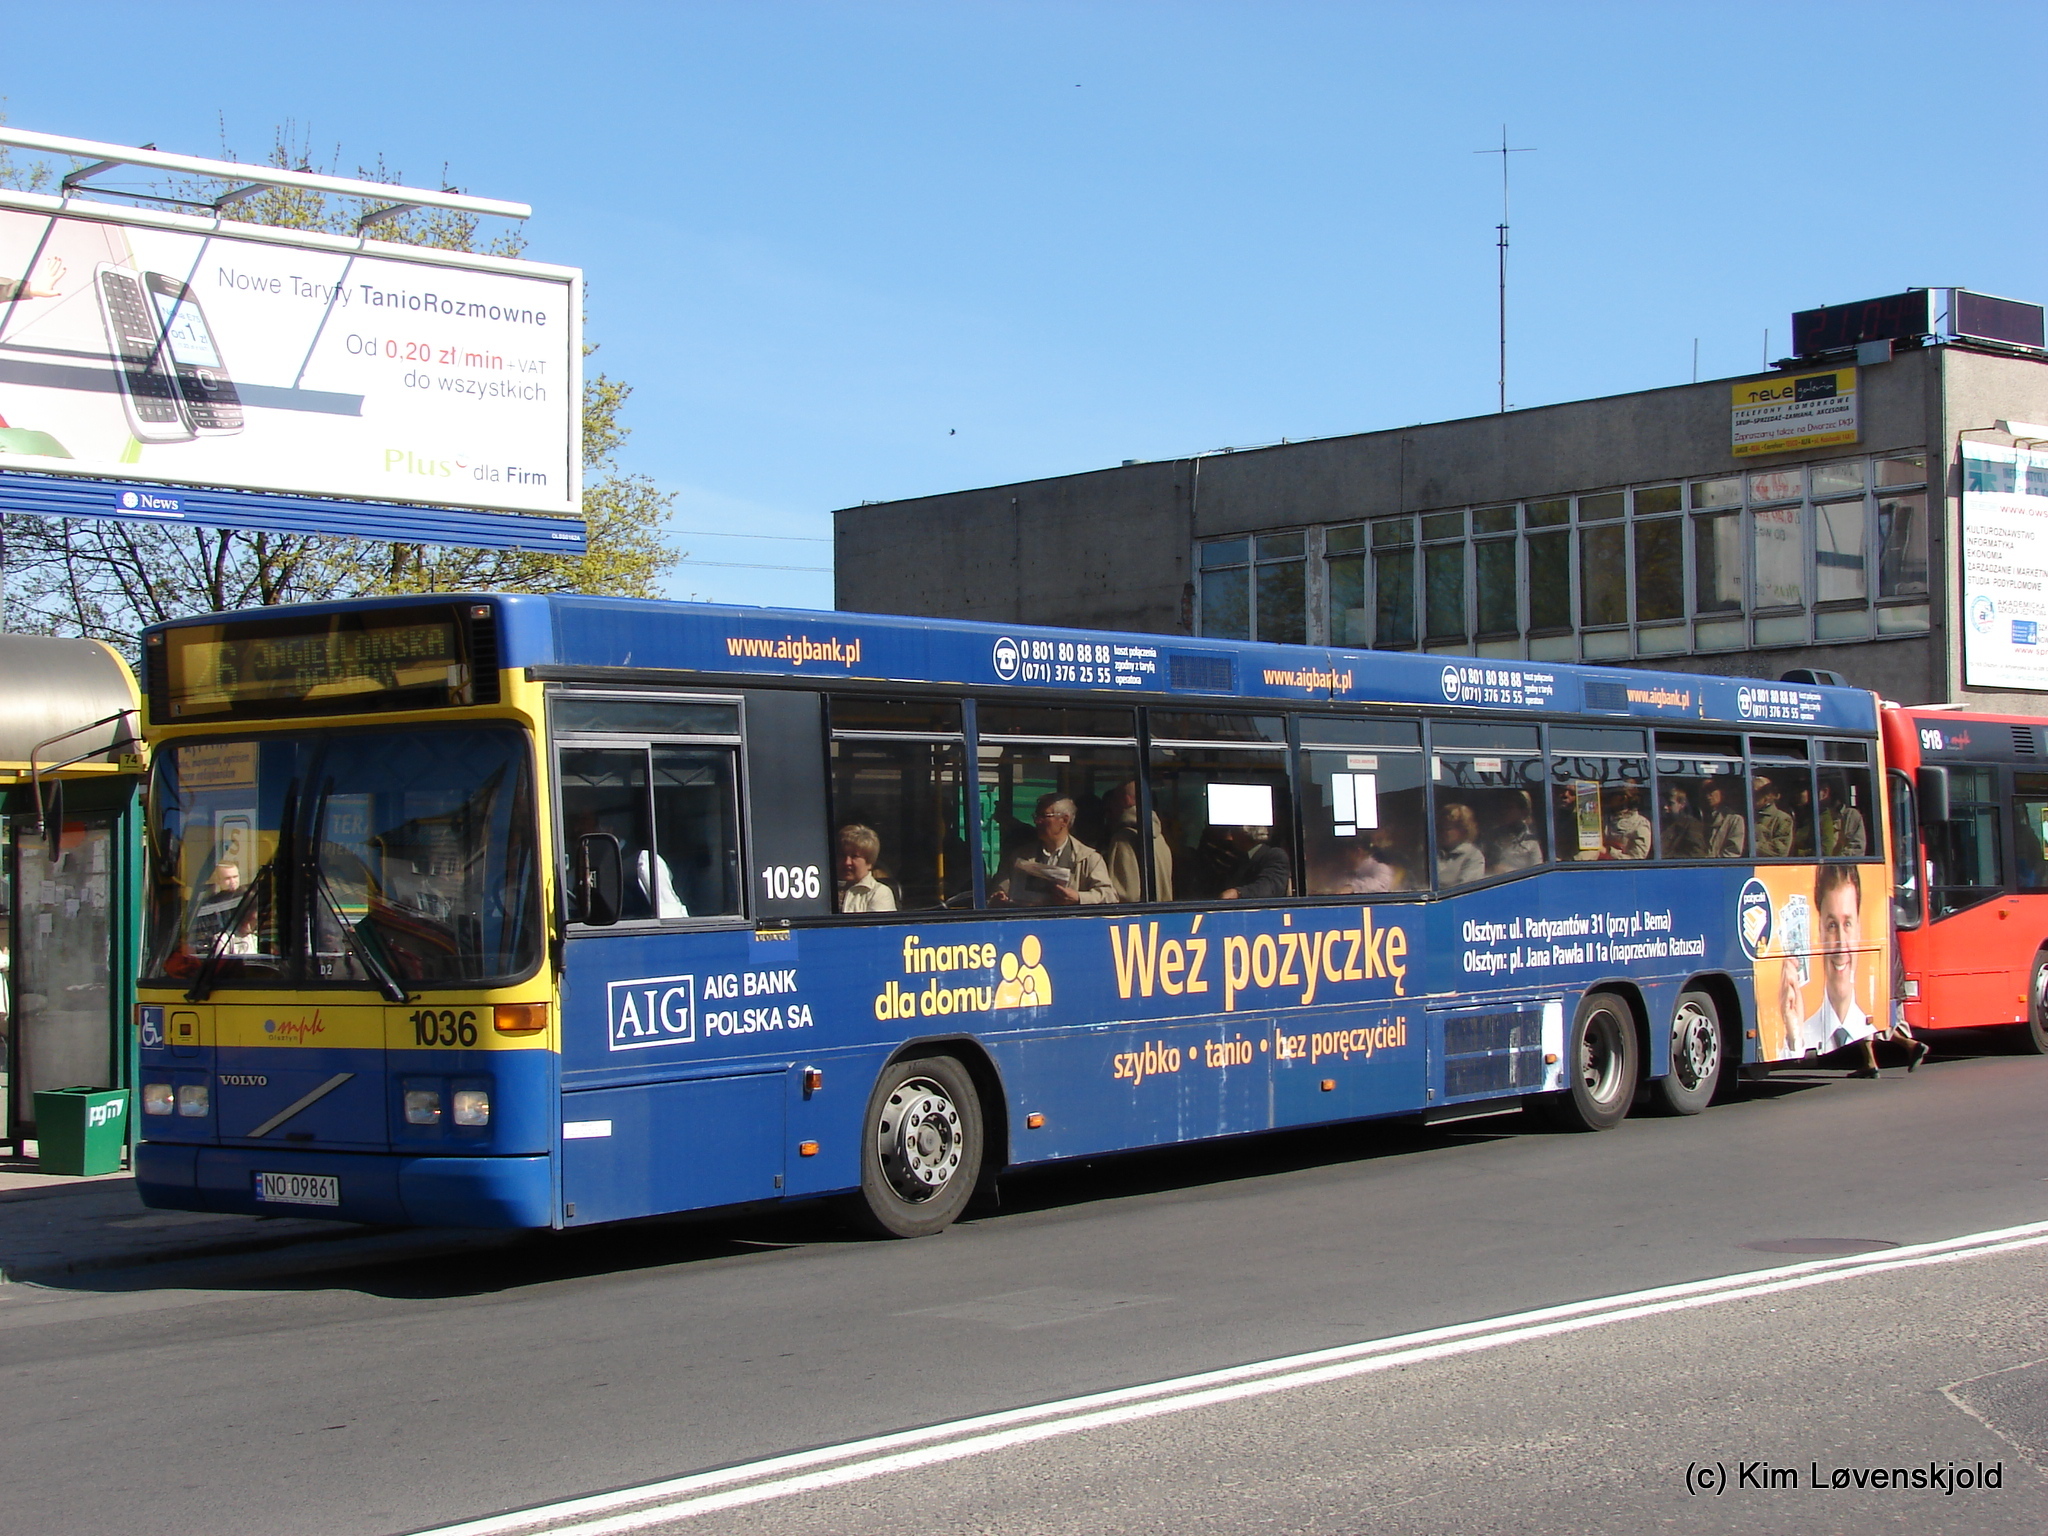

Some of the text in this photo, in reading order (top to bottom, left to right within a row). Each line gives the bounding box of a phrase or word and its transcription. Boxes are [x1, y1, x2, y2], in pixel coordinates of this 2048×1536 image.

[219, 267, 547, 326] Nowe Taryfy TanioRozmowne
[346, 333, 377, 357] Od
[385, 339, 431, 363] 0,20
[404, 369, 546, 401] do wszystkich
[1735, 407, 1781, 418] TELEFONY
[1807, 423, 1837, 432] Dworzec
[384, 449, 547, 486] Plus dla Firm
[140, 494, 179, 510] News
[1966, 525, 2035, 540] KULTUROZNAWSTWO
[1966, 537, 2014, 549] INFORMATYKA
[1966, 548, 2002, 559] EKONOMIA
[1967, 576, 2042, 591] STUDIA PODYPLOMOWE
[726, 635, 861, 668] www.aigbank.pl
[1021, 640, 1029, 659] 0
[1032, 641, 1054, 661] 801
[1059, 642, 1075, 662] 80
[1077, 644, 1092, 664] 88
[1095, 645, 1111, 664] 88
[1021, 662, 1051, 683] (071)
[1055, 664, 1076, 682] 376
[1079, 666, 1094, 683] 25
[1097, 668, 1111, 684] 55
[1263, 667, 1353, 694] www.aigbank.pl
[1460, 667, 1467, 683] 0
[1468, 668, 1484, 685] 801
[1485, 670, 1497, 686] 80
[1498, 670, 1509, 687] 88
[1510, 671, 1522, 688] 88
[1461, 686, 1482, 703] (071)
[1483, 688, 1498, 703] 376
[1500, 689, 1510, 703] 25
[1512, 690, 1523, 704] 55
[1626, 687, 1690, 710] www.aigbank.pl
[1920, 729, 1943, 750] 918
[124, 754, 138, 764] 74
[761, 865, 821, 899] 1036
[1462, 919, 1508, 947] Olsztyn:
[1509, 917, 1523, 938] ul.
[1525, 913, 1589, 943] Partyzantów
[1590, 916, 1603, 935] 31
[1606, 912, 1629, 939] (przy
[1630, 911, 1642, 938] pl.
[903, 934, 998, 974] finanse
[1109, 906, 1408, 1012] Weź pożyczkę
[1463, 934, 1706, 976] Olsztyn: pl. Jana Pawła II 1a (naprzeciwko Ratusza)
[320, 965, 333, 975] D2
[703, 969, 798, 1000] AIG BANK
[616, 987, 689, 1039] AIG
[874, 978, 992, 1021] dla domu
[409, 1010, 478, 1047] 1036
[705, 1004, 814, 1037] POLSKA SA
[1113, 1016, 1407, 1085] szybko tanio bez poręczycieli
[219, 1075, 268, 1086] VOLVO
[89, 1098, 124, 1127] pgm
[263, 1176, 336, 1199] NO 09861
